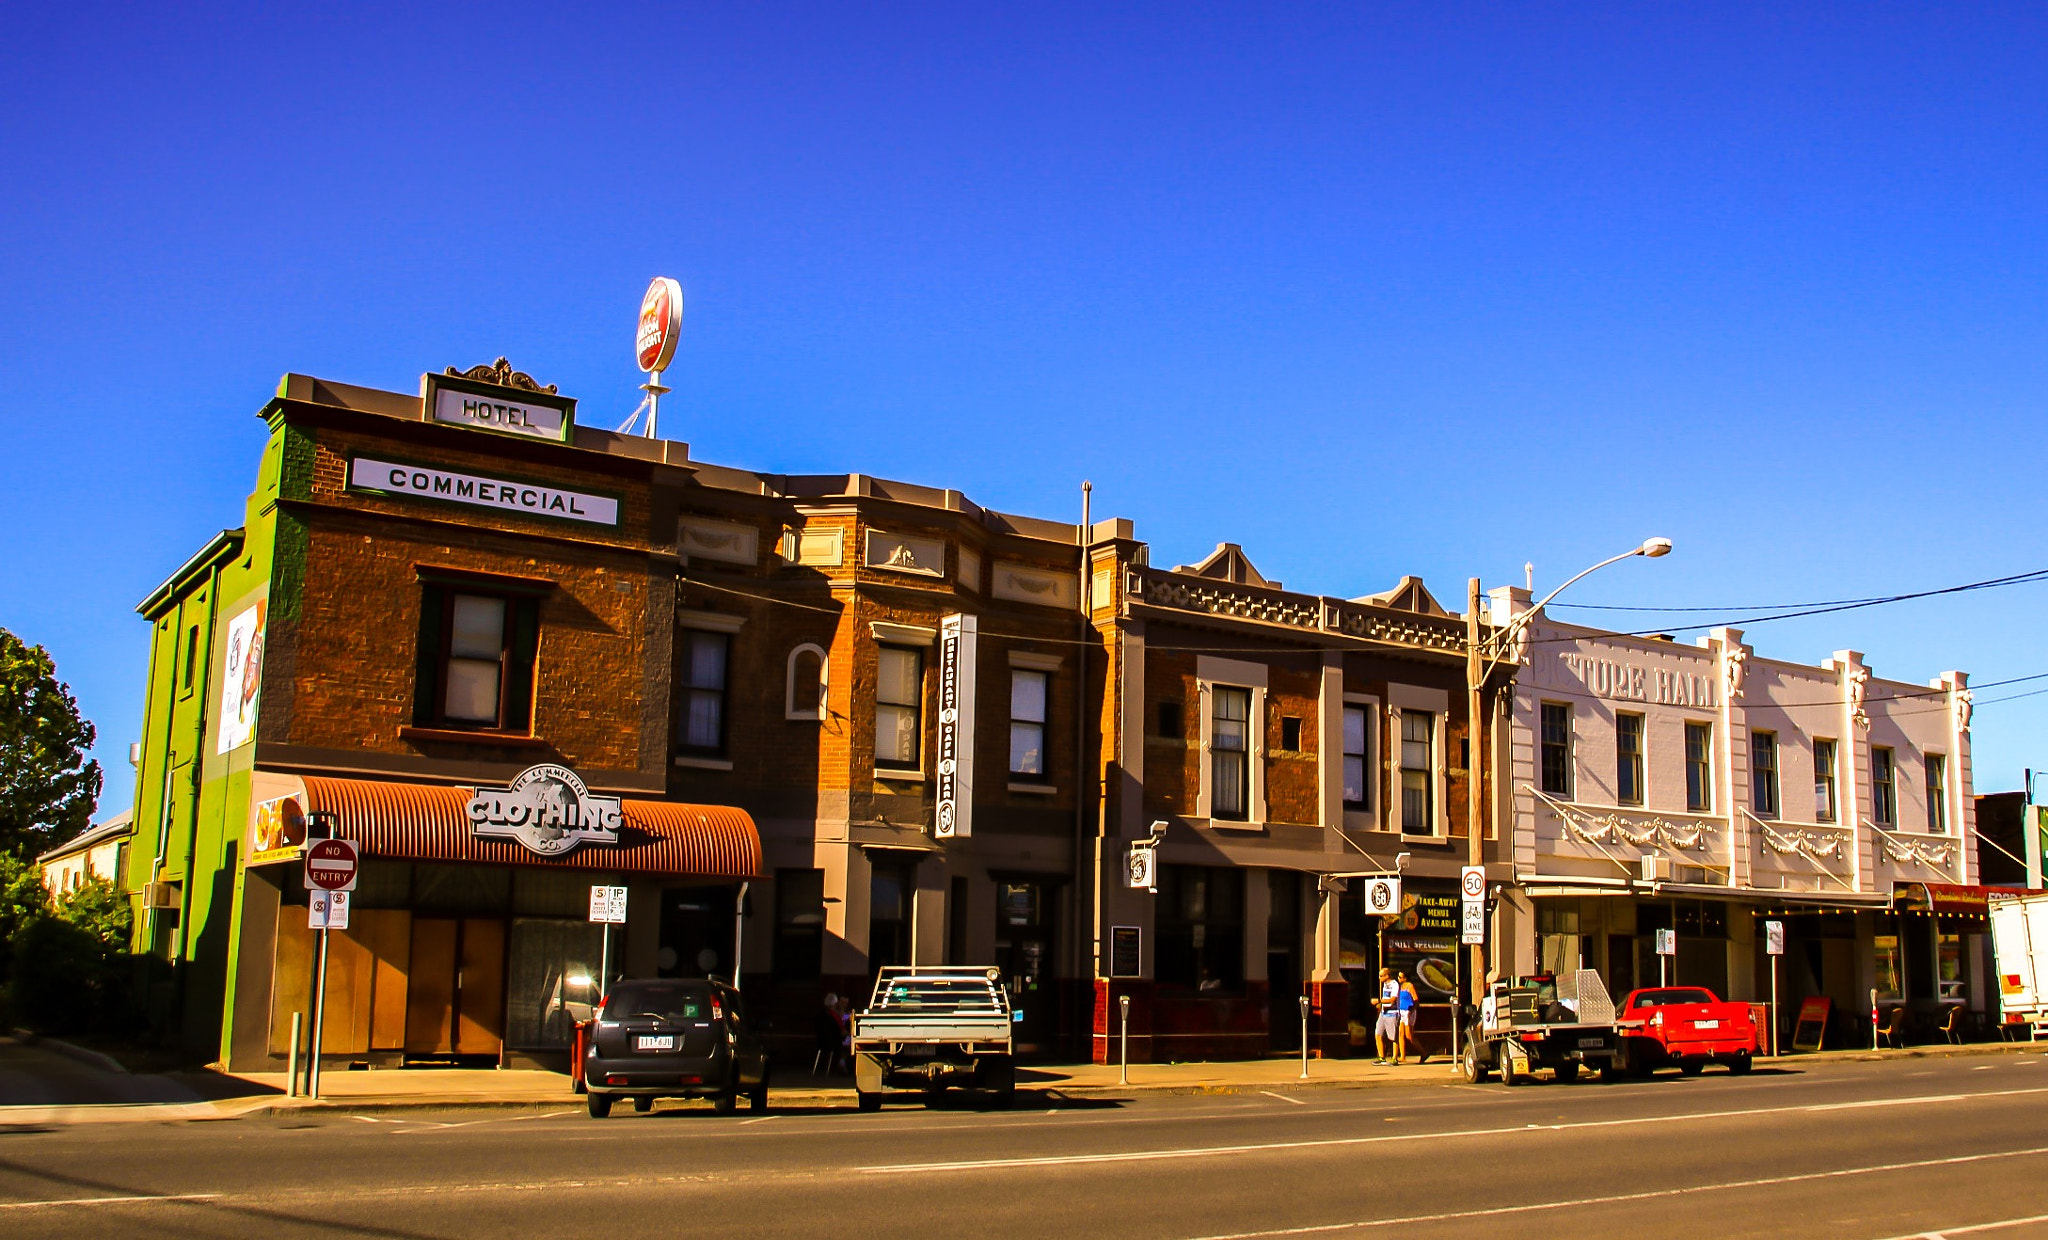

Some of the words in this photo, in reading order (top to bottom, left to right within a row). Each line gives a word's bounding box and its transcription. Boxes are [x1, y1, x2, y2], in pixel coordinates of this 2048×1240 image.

[462, 399, 535, 428] HOTEL
[388, 469, 585, 515] COMMERCIAL
[945, 638, 955, 708] RESTAURANT
[1653, 667, 1719, 708] HALL
[944, 725, 953, 758] CAFE
[513, 777, 529, 793] THE
[531, 768, 585, 798] COMMERCIAL
[943, 775, 951, 799] BAR
[466, 797, 622, 832] CLOTHING
[325, 847, 341, 856] NO
[312, 871, 349, 882] ENTRY
[1133, 866, 1143, 879] 68
[1466, 877, 1482, 891] 50
[1375, 893, 1387, 906] 68
[1419, 897, 1458, 908] TAKE-AWAY
[1420, 917, 1456, 929] AVAILABLE
[1465, 922, 1482, 931] LANE
[1388, 939, 1412, 949] DAILY
[1413, 939, 1449, 949] SPECIALS
[686, 1006, 695, 1016] P
